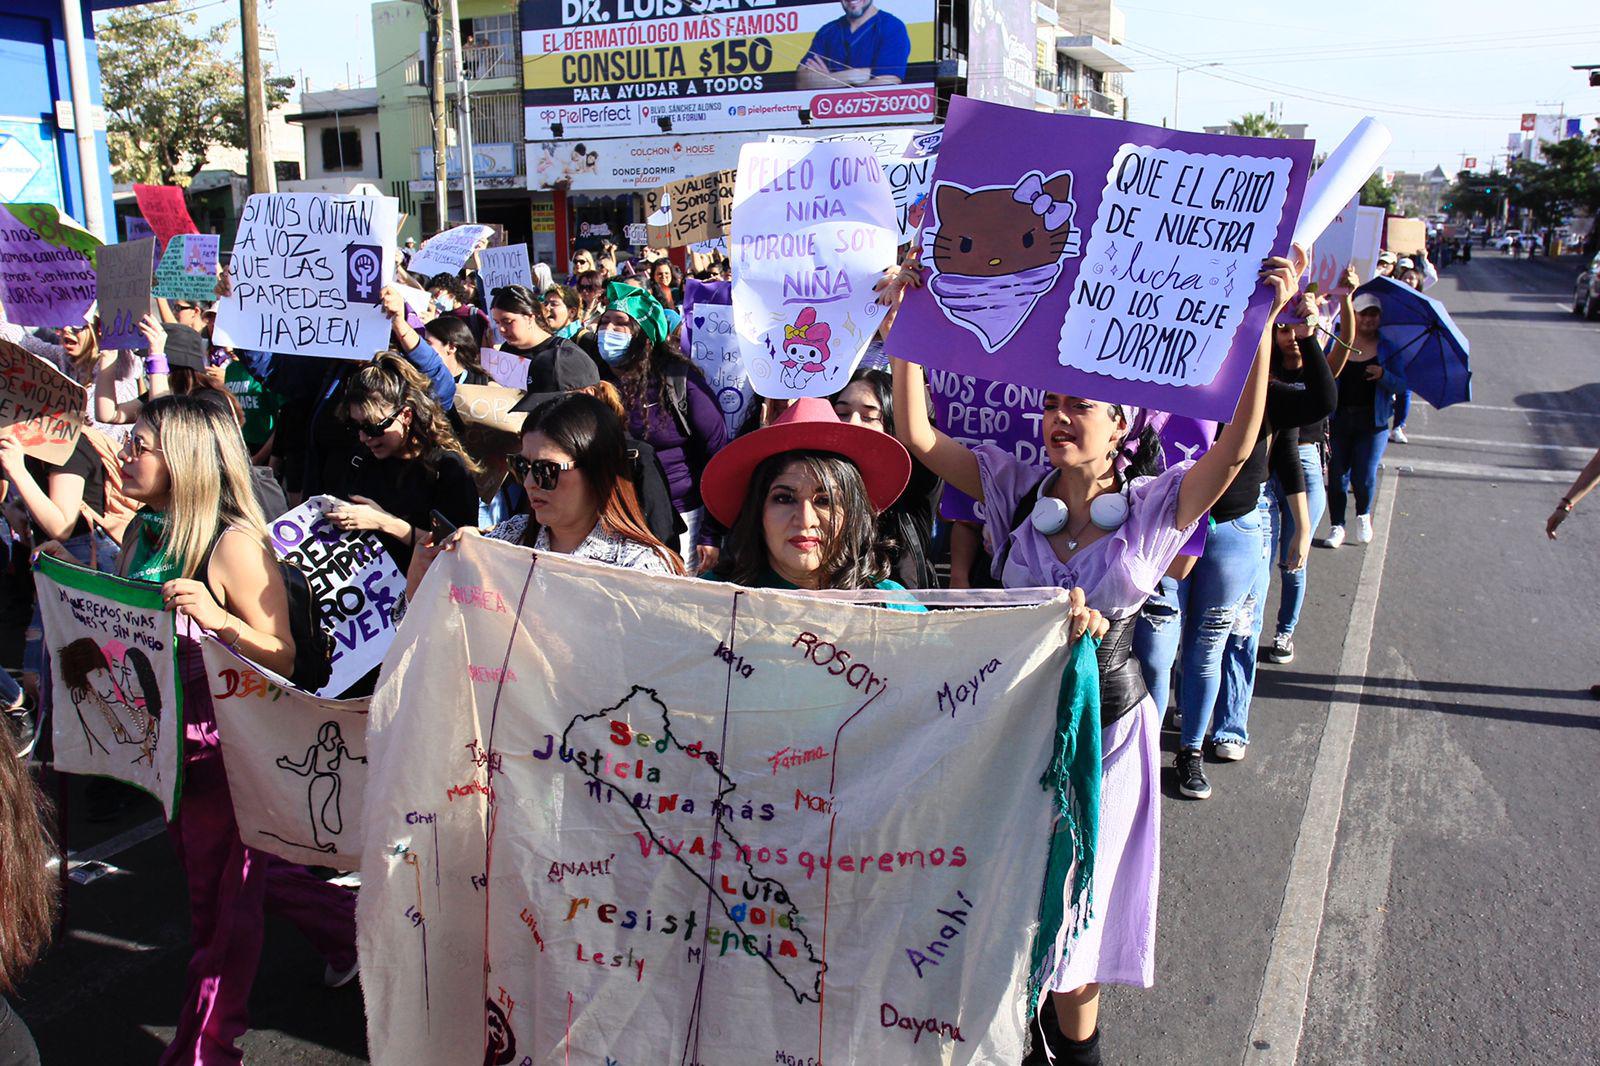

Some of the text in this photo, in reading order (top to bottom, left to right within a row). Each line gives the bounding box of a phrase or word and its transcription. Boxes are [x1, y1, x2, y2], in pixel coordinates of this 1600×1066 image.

[543, 11, 799, 52] EL DERMATÓLOGO MÁS FAMOSO
[562, 37, 773, 84] CONSULTA $150
[574, 76, 764, 102] PARA AYUDAR A TODOS
[835, 94, 930, 115] 6675730700
[559, 104, 632, 124] PielPerfect
[669, 103, 696, 113] SÁNCHEZ
[697, 102, 722, 111] ALONSO
[631, 144, 715, 157] COLCHON HOUSE
[612, 166, 675, 176] DONDE DORMIR
[748, 157, 883, 193] PELEO COMO
[1116, 152, 1275, 213] QUE EL GRITO
[264, 197, 300, 229] NOS
[308, 197, 373, 235] QUITAN
[677, 189, 717, 211] SOMOS
[786, 195, 847, 222] NIÑA
[265, 228, 321, 257] VOZ
[1106, 204, 1255, 253] DE NUESTRA
[33, 247, 92, 263] calladas
[502, 250, 522, 269] not
[741, 229, 878, 262] PORQUE SOY
[228, 253, 270, 281] QUE
[284, 257, 334, 281] LAS
[783, 265, 853, 297] NIÑA
[1118, 242, 1203, 290] lucha
[233, 283, 346, 313] PAREDES
[1077, 280, 1230, 329] NO LOS DEJE
[259, 313, 359, 350] HABLEN.
[24, 381, 82, 417] VIOLAN
[930, 368, 976, 404] NOS
[13, 404, 78, 441] MATAN
[948, 401, 1010, 435] PERO
[99, 620, 108, 632] Y
[113, 624, 130, 640] SIN
[937, 658, 1002, 718] Mayra
[610, 720, 672, 753] Sed
[735, 844, 788, 865] nos
[798, 846, 968, 880] queremos
[721, 874, 790, 904] Luto
[576, 943, 645, 983] Lesly
[880, 1002, 966, 1044] Dayana
